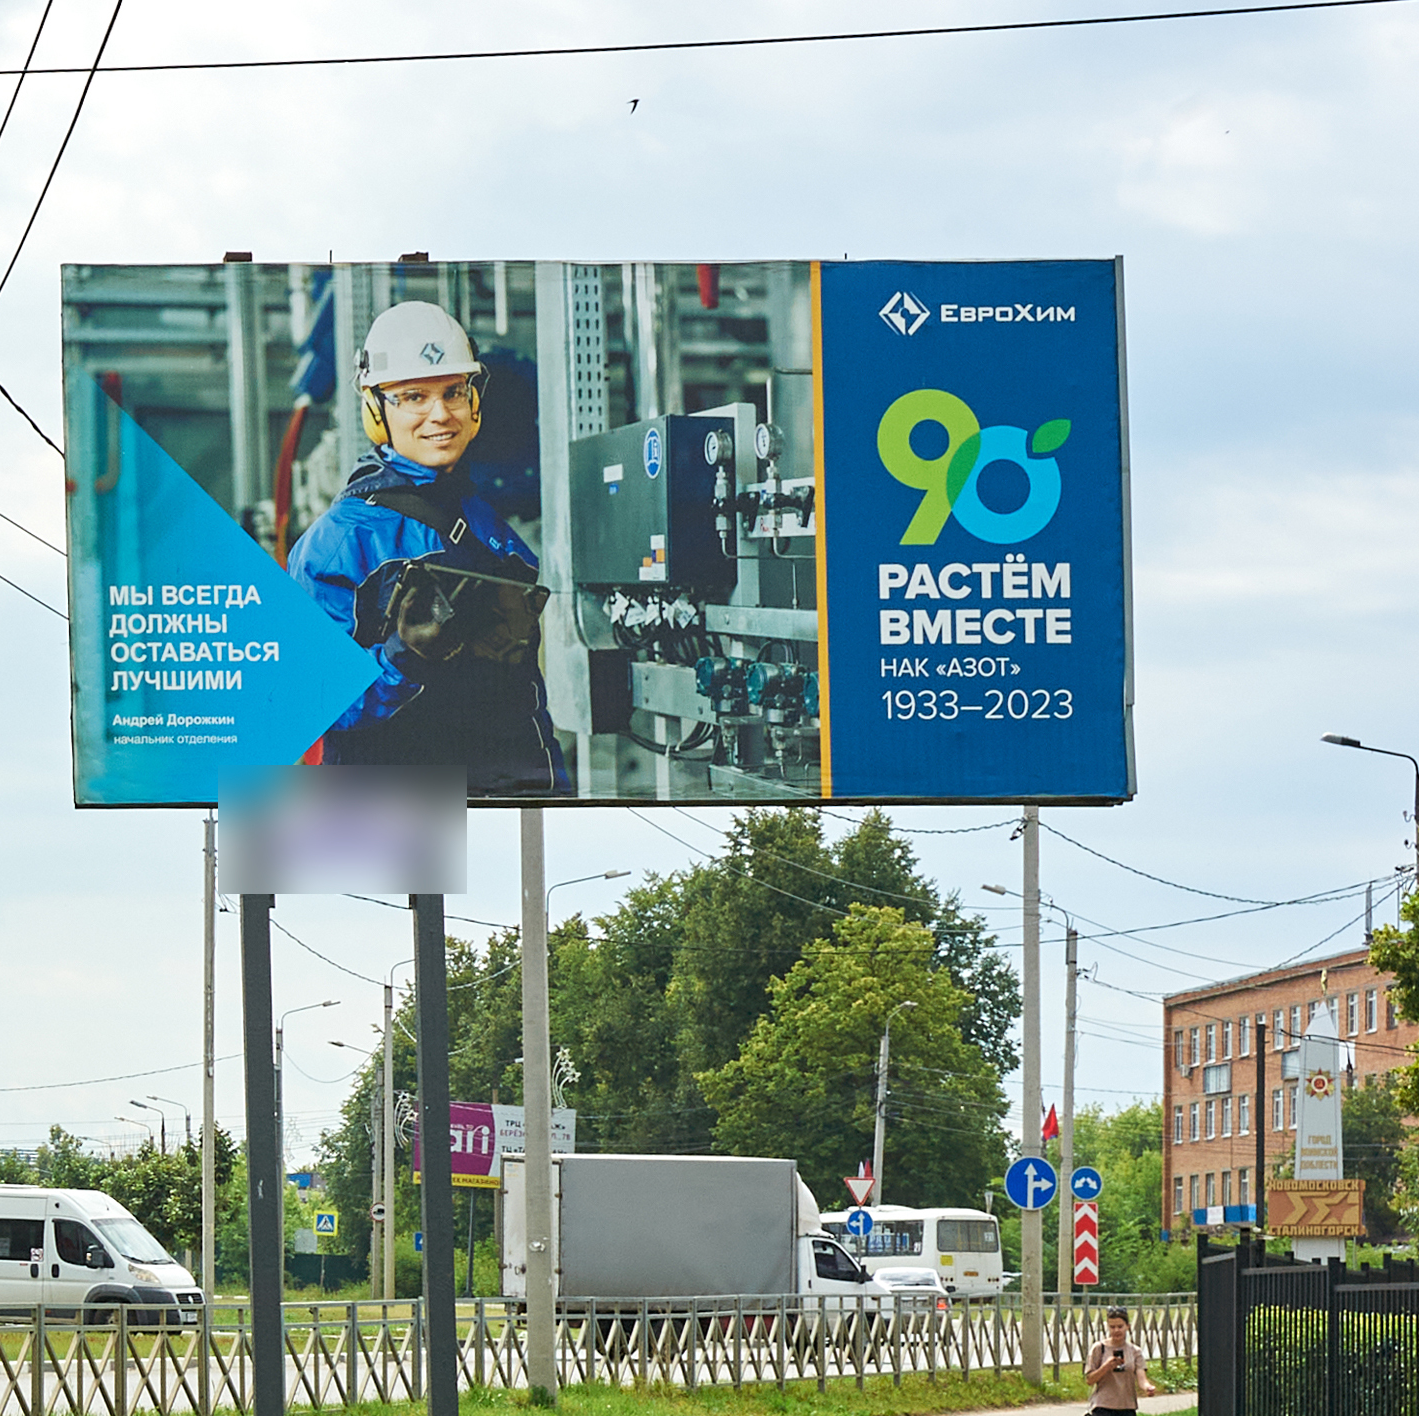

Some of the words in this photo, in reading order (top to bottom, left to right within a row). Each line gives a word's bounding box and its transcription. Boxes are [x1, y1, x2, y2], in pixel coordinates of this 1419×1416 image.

[876, 388, 1062, 546] 90
[878, 553, 1071, 600] РАСТЁМ
[109, 585, 153, 606] МЫ
[161, 584, 262, 608] ВСЕГДА
[108, 613, 228, 638] ДОЛЖНЫ
[879, 608, 1072, 645] ВМЕСТЕ
[110, 641, 280, 663] ОСТАВАТЬСЯ
[880, 657, 930, 677] НАК
[935, 656, 1021, 677] «АЗОТ»
[110, 669, 243, 691] ЛУЧШИМИ
[881, 689, 1074, 720] 1933–2023
[112, 713, 164, 728] Андрей
[166, 713, 235, 727] Дорожкин
[113, 735, 174, 745] начальник
[176, 734, 238, 744] отделения
[1268, 1180, 1359, 1191] НОВОМОСКОВСК
[1268, 1225, 1359, 1236] СТАЛИНОГОРСК
